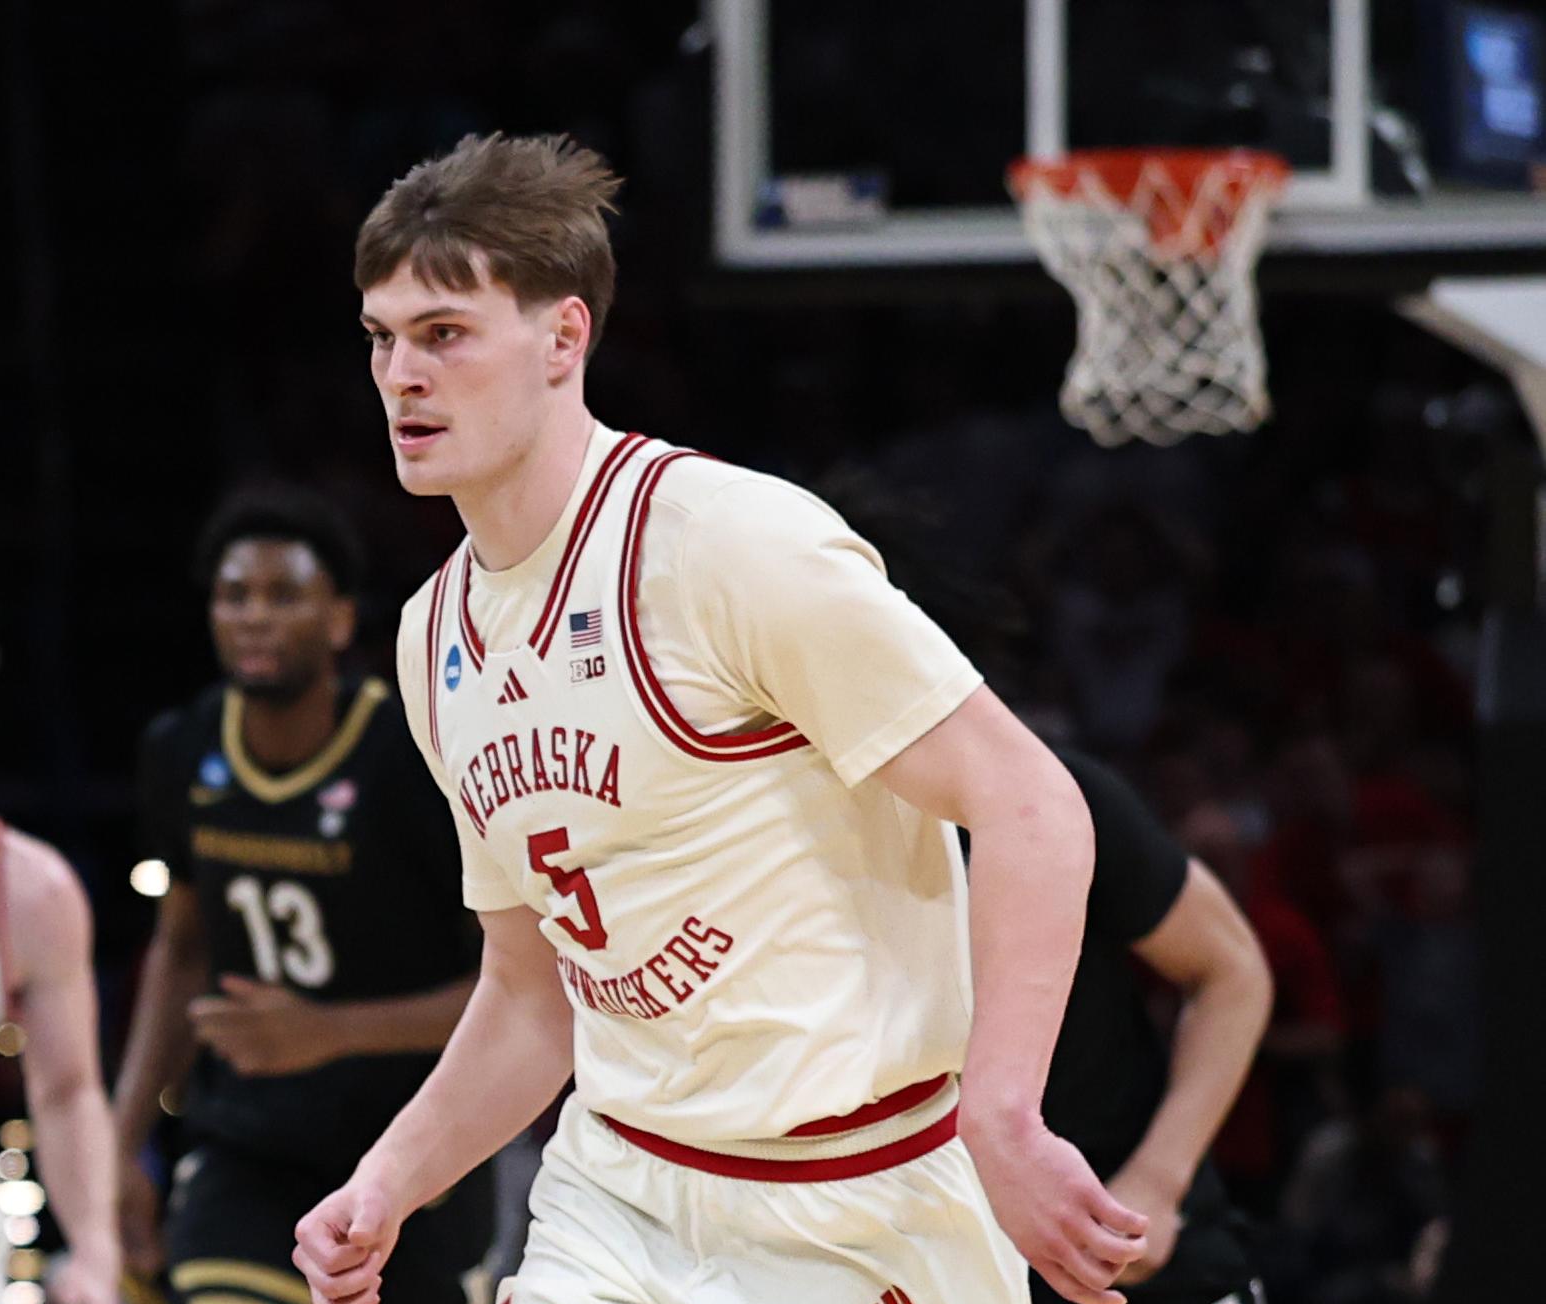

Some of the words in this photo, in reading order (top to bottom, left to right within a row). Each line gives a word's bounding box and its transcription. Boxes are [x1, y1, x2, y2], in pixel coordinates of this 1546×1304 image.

[459, 726, 622, 841] NEBRASKA
[226, 874, 335, 988] 13
[527, 826, 609, 951] 5
